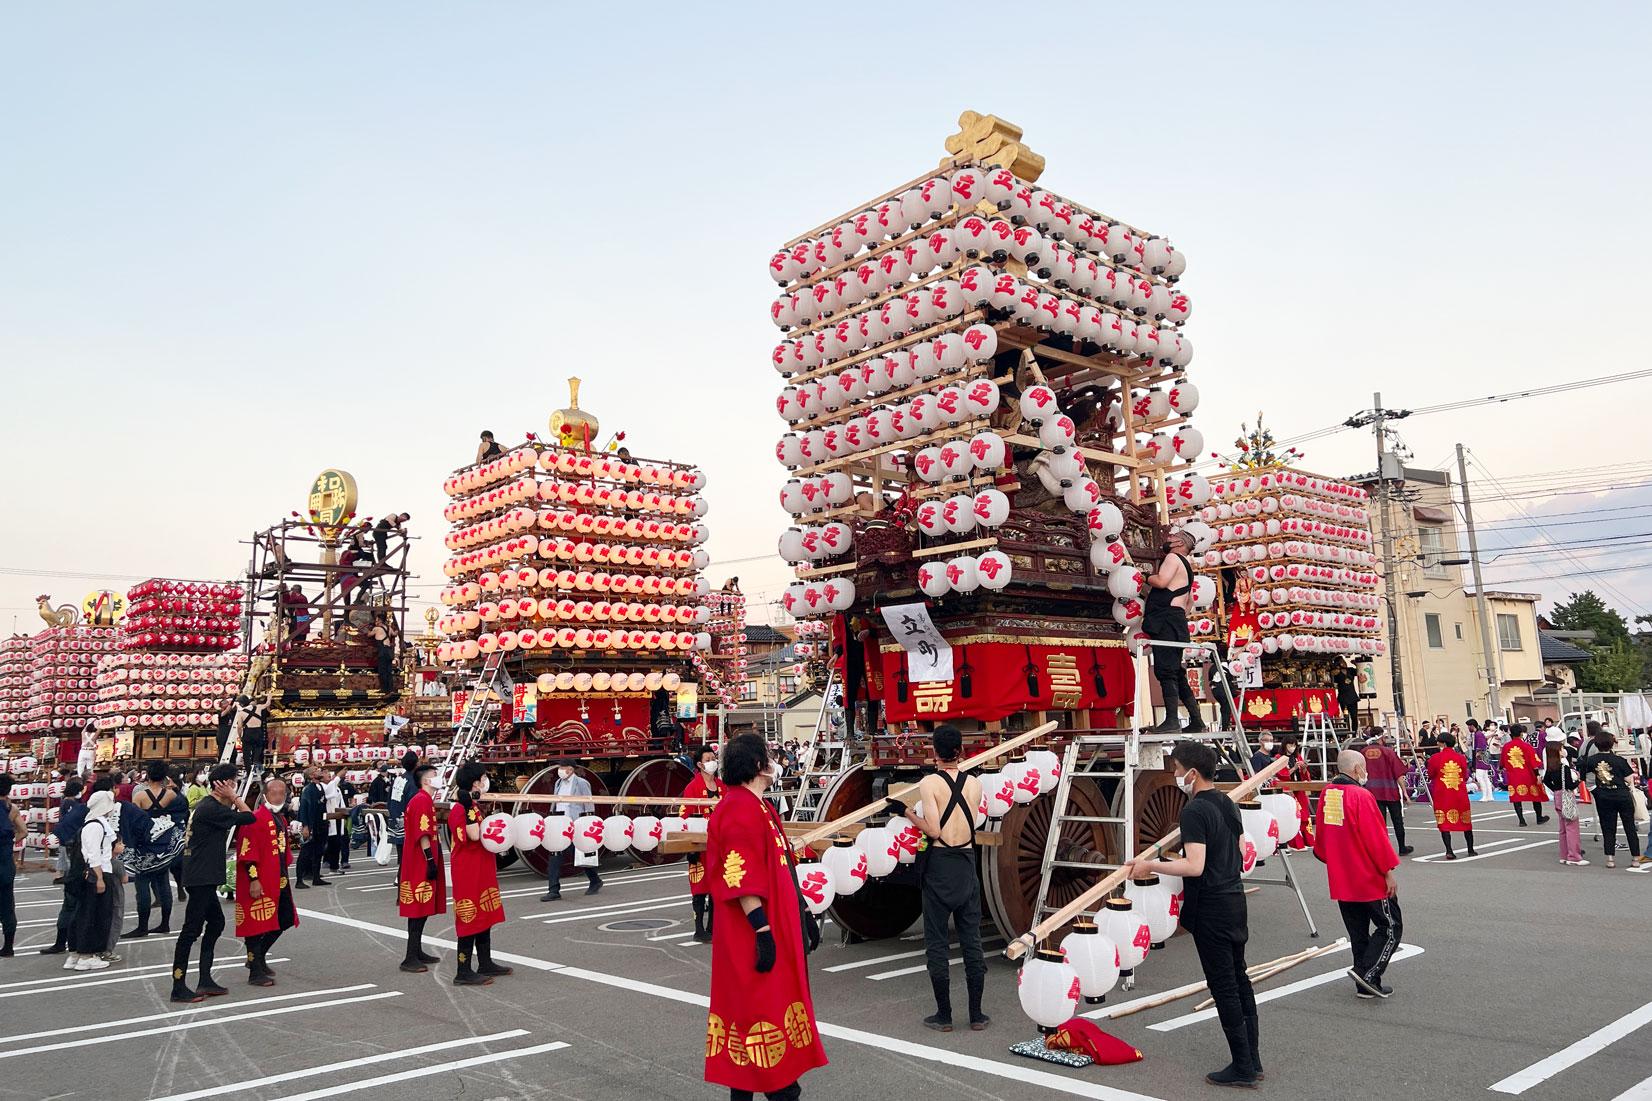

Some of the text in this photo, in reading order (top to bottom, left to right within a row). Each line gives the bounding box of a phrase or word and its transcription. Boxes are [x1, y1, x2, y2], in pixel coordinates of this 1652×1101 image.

[952, 175, 975, 200] 立
[993, 170, 1014, 192] 立
[1055, 204, 1072, 224] 立
[962, 218, 986, 237] 町
[992, 221, 1012, 240] 町
[1013, 228, 1032, 246] 町
[1078, 219, 1094, 237] 立
[1094, 226, 1109, 245] 立
[928, 232, 948, 254] 町
[791, 244, 809, 264] 立
[857, 265, 875, 285] 町
[880, 256, 898, 274] 町
[960, 268, 978, 291] 立
[994, 275, 1015, 296] 立
[1138, 280, 1152, 299] 町
[813, 284, 829, 303] 町
[931, 286, 948, 309] 立
[1021, 289, 1038, 309] 立
[1042, 297, 1060, 318] 立
[1170, 296, 1188, 313] 立
[835, 322, 849, 343] 立
[964, 329, 988, 351] 町
[839, 374, 857, 392] 町
[796, 390, 810, 409] 町
[937, 391, 959, 414] 立
[968, 383, 992, 406] 立
[1028, 388, 1052, 409] 町
[845, 425, 861, 448] 立
[940, 448, 959, 468] 町
[970, 439, 990, 461] 町
[915, 454, 935, 475] 町
[802, 483, 819, 502] 町
[820, 480, 833, 497] 町
[1179, 480, 1193, 500] 立
[918, 506, 936, 528] 立
[942, 501, 958, 524] 立
[973, 495, 992, 519] 立
[1088, 508, 1103, 530] 立
[803, 532, 818, 553] 立
[822, 527, 841, 548] 立
[1107, 543, 1125, 564] 町
[946, 565, 964, 585] 町
[978, 558, 1003, 580] 町
[804, 588, 822, 608] 町
[823, 585, 838, 603] 町
[901, 614, 938, 668] 立町
[1017, 768, 1040, 796] 立
[995, 781, 1014, 808] 立
[483, 819, 507, 844] 立
[583, 821, 604, 844] 立
[898, 825, 922, 856] 立
[800, 871, 828, 904] 立
